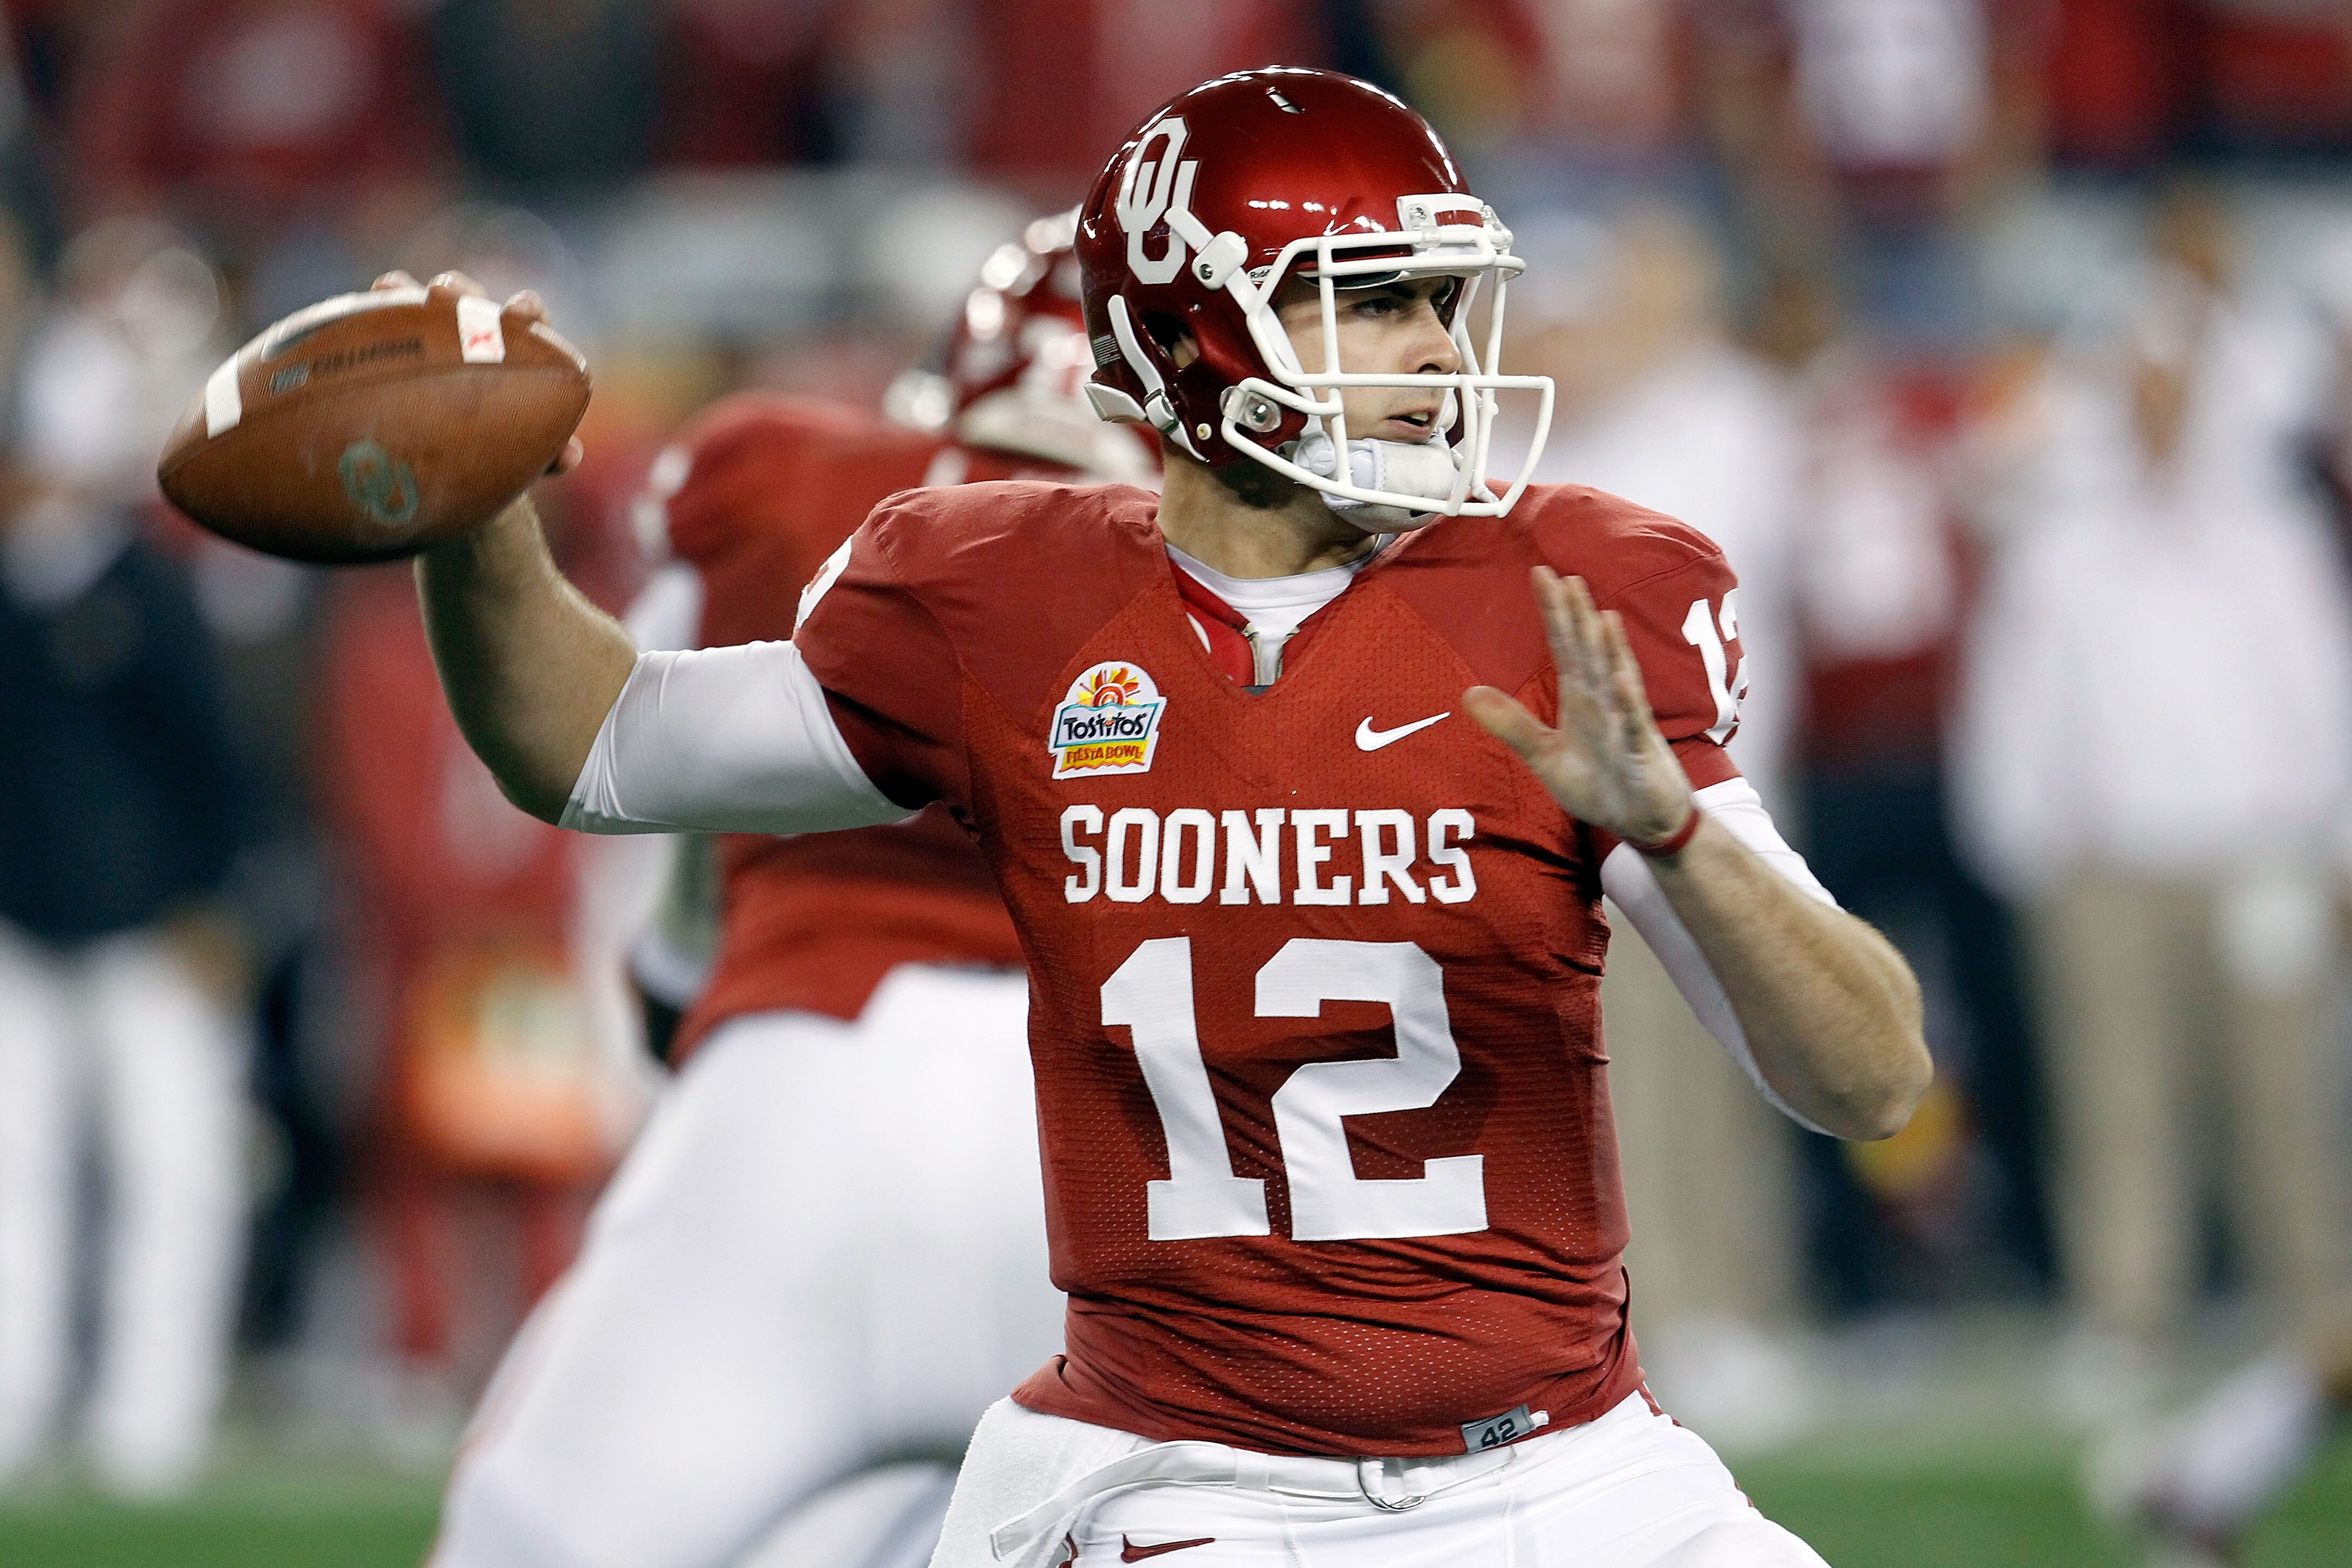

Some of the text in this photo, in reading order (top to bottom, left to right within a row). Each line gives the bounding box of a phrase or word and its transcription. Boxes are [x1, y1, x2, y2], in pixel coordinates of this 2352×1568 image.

[1115, 117, 1199, 285] OU
[1067, 745, 1144, 764] FIESTA BOWL
[1060, 804, 1478, 906] SOONERS
[1100, 936, 1490, 1242] 12
[1481, 1417, 1519, 1448] 42
